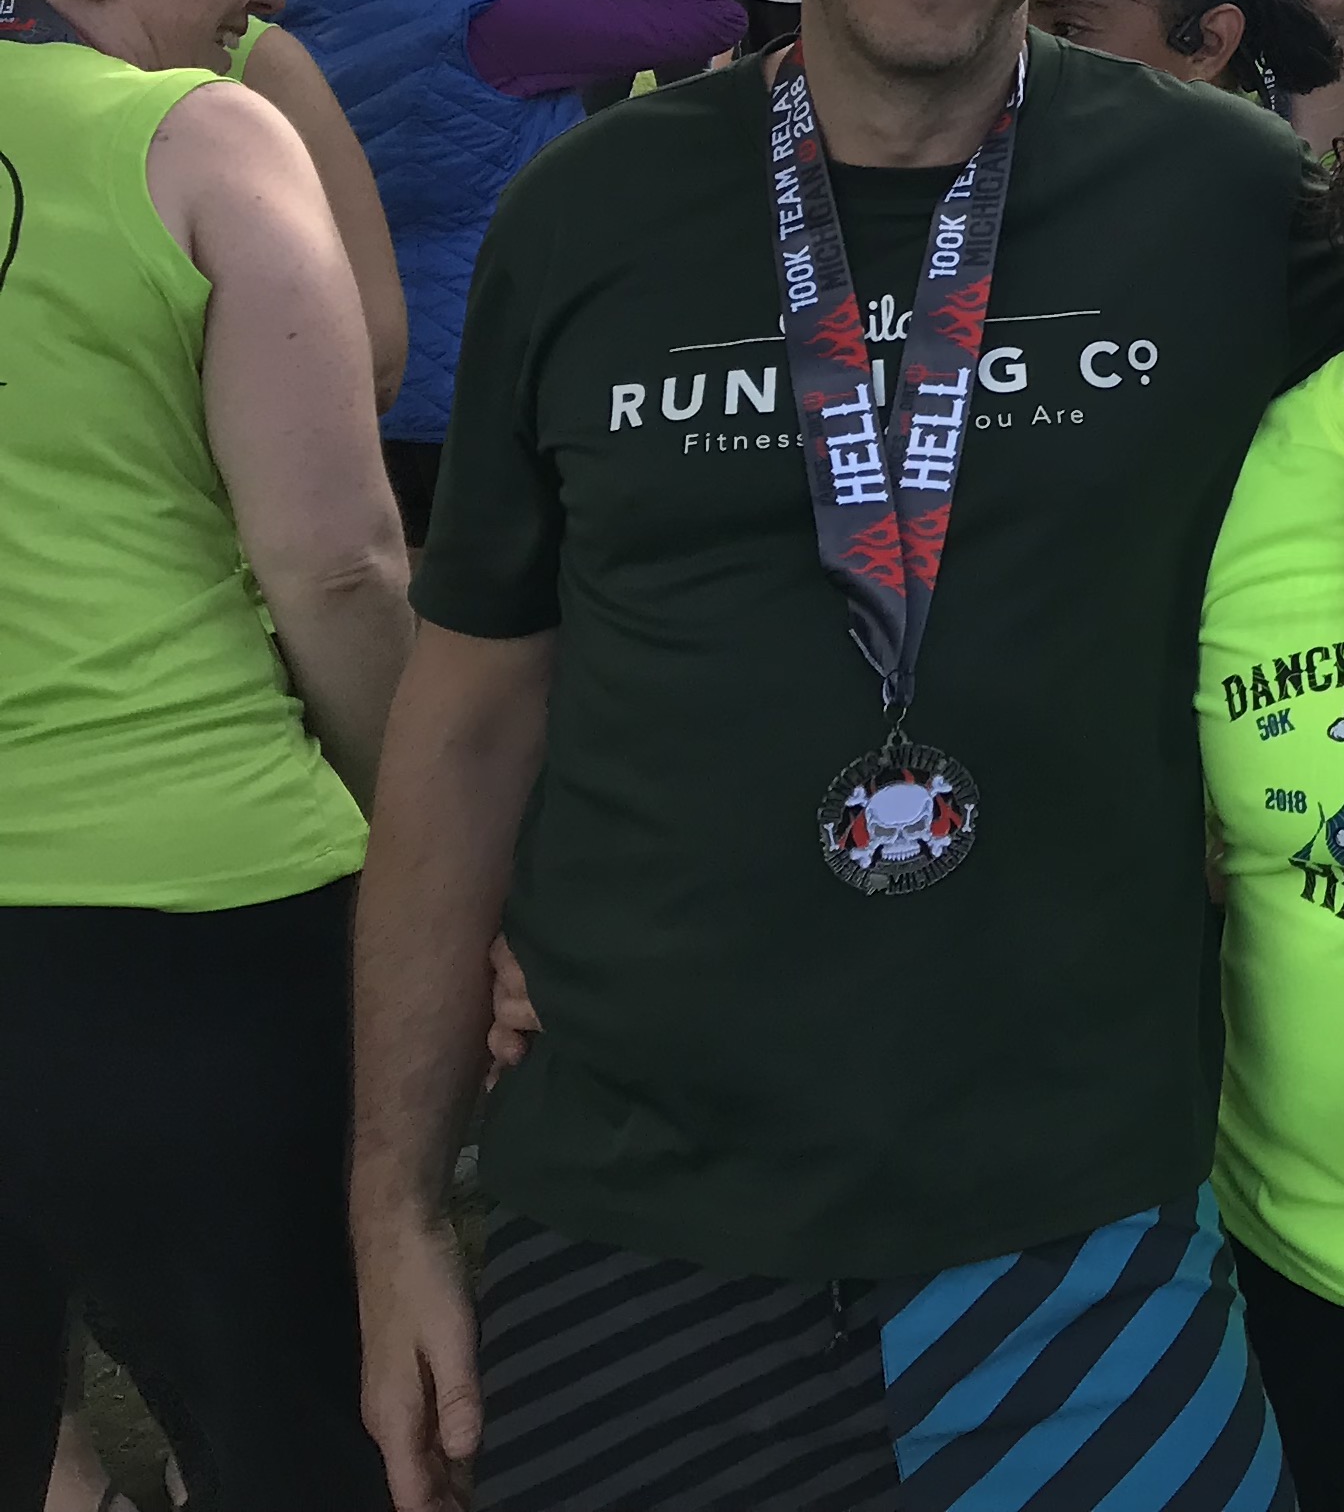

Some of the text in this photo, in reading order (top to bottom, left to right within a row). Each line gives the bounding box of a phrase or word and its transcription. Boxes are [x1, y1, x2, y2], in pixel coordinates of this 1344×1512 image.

[791, 74, 815, 138] 2018
[771, 80, 818, 312] 100K TEAM RELAY
[928, 214, 967, 279] 100K
[610, 347, 1028, 431] RUNIG
[975, 405, 1085, 430] ou Are
[820, 383, 888, 505] HELL
[900, 367, 971, 491] HELL
[1256, 708, 1295, 741] 50K
[1265, 788, 1307, 814] 2018
